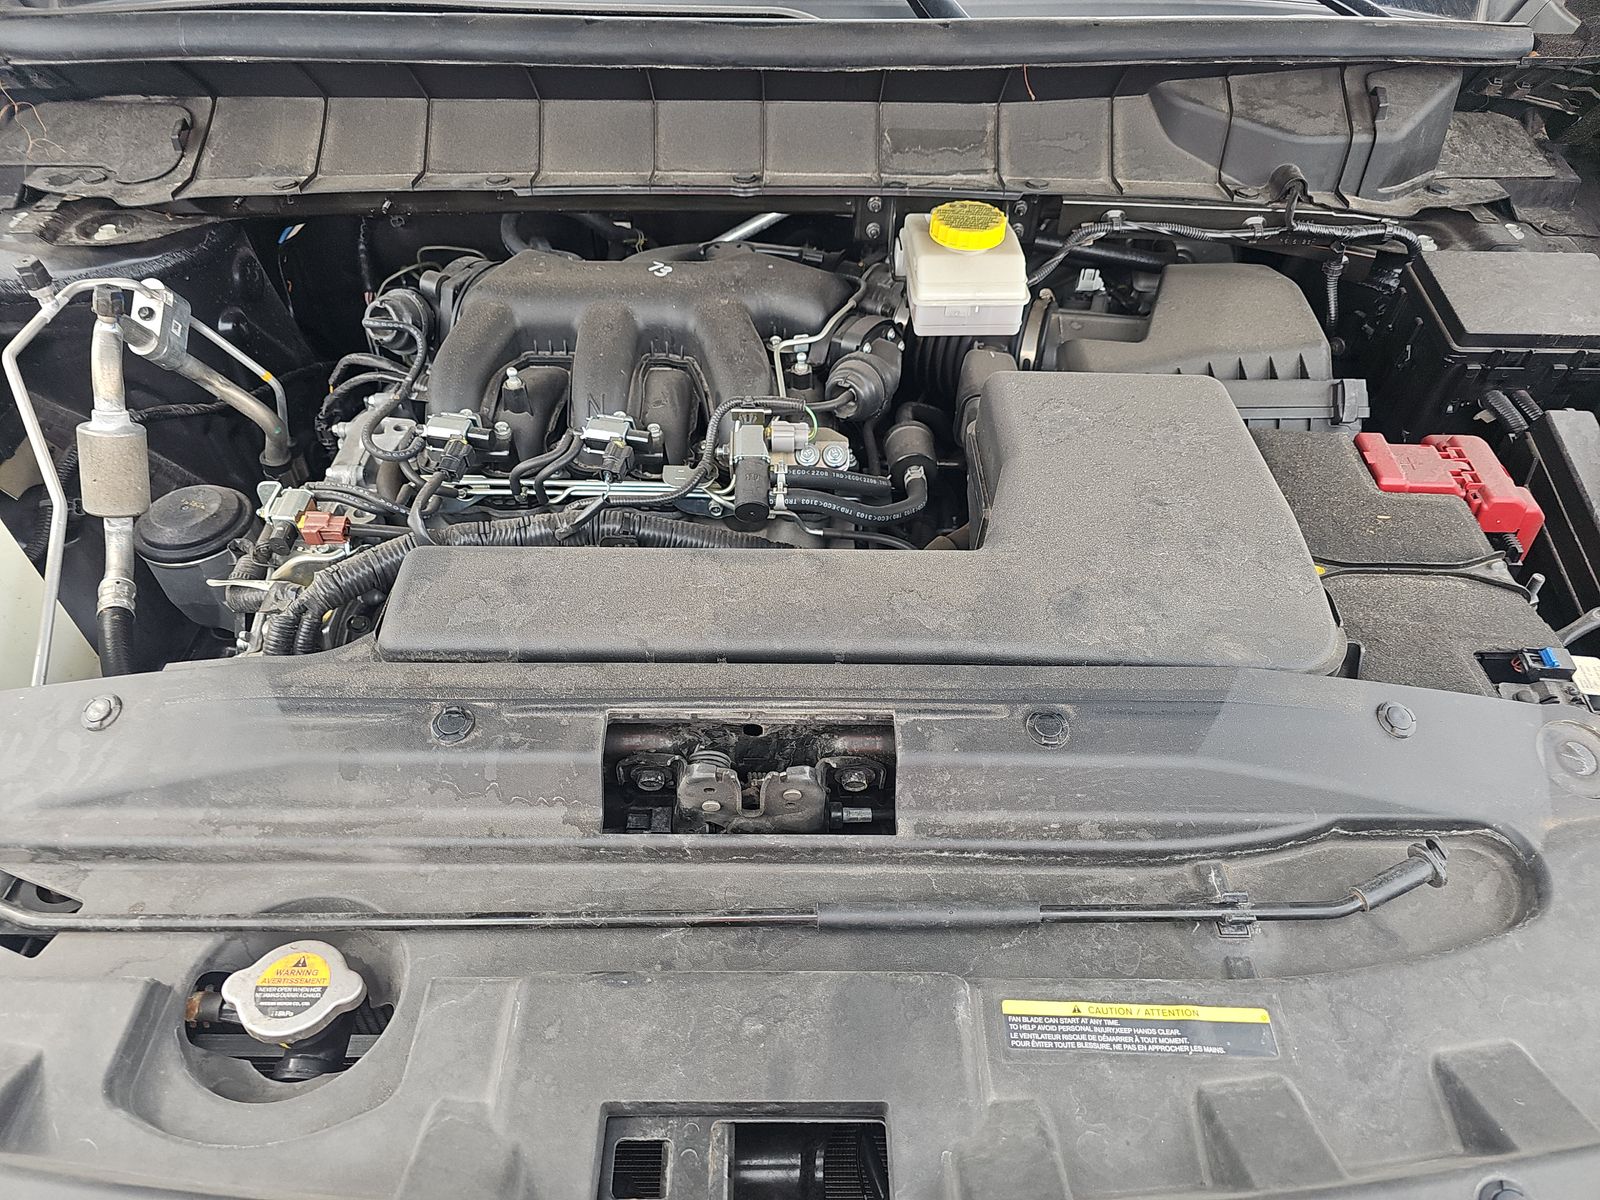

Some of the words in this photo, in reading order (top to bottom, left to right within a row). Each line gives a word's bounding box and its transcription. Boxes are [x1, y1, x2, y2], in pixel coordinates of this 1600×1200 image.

[1088, 1006, 1133, 1015] CAUTION
[1136, 1008, 1140, 1016] /
[1144, 1008, 1200, 1017] ATTENTION
[1031, 1038, 1054, 1048] ÉVITER
[1076, 1042, 1112, 1050] BLESSURE,
[1098, 1034, 1134, 1042] DÉMARRER
[1134, 1034, 1140, 1043] À
